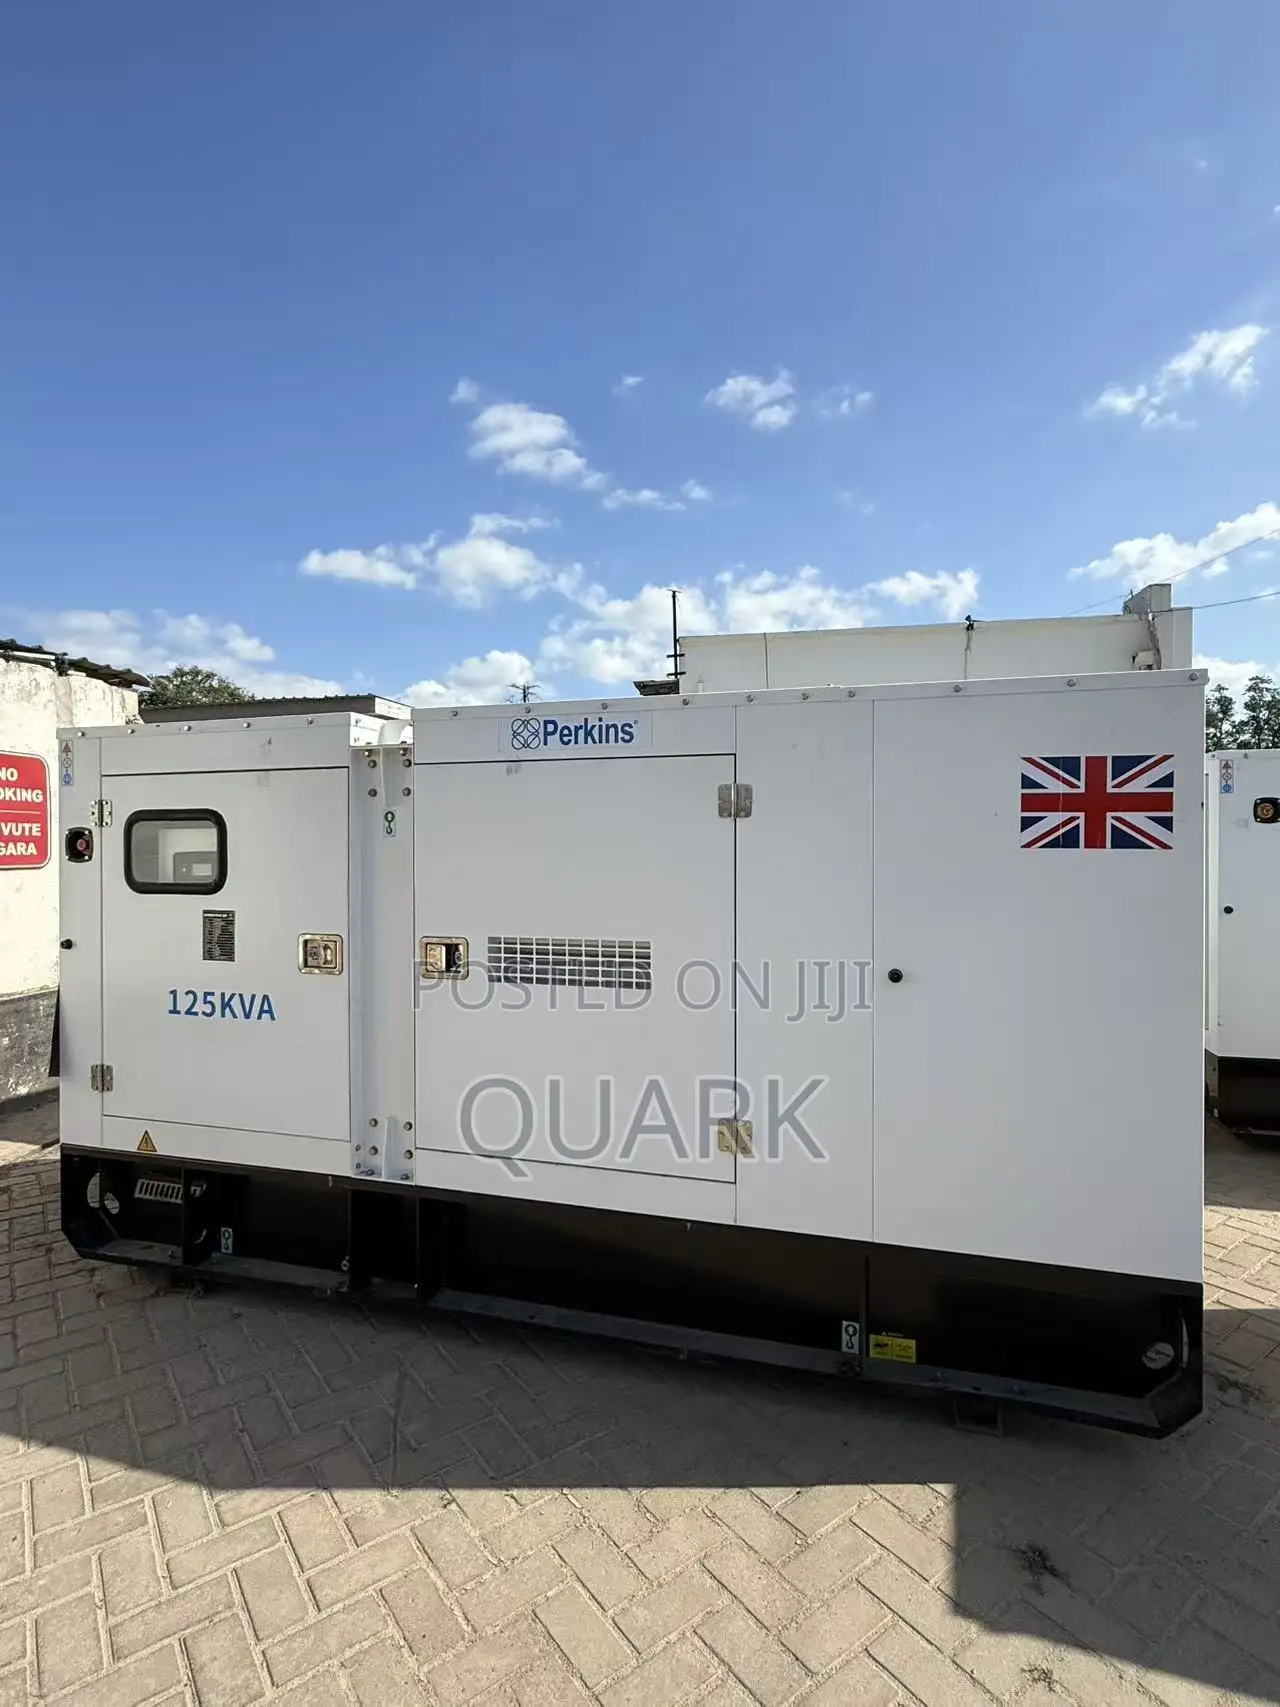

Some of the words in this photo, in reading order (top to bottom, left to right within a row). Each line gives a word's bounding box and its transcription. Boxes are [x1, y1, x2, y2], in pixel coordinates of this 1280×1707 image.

[543, 717, 635, 747] Perkins
[1, 822, 42, 836] VUTE
[168, 989, 276, 1021] 125KVA
